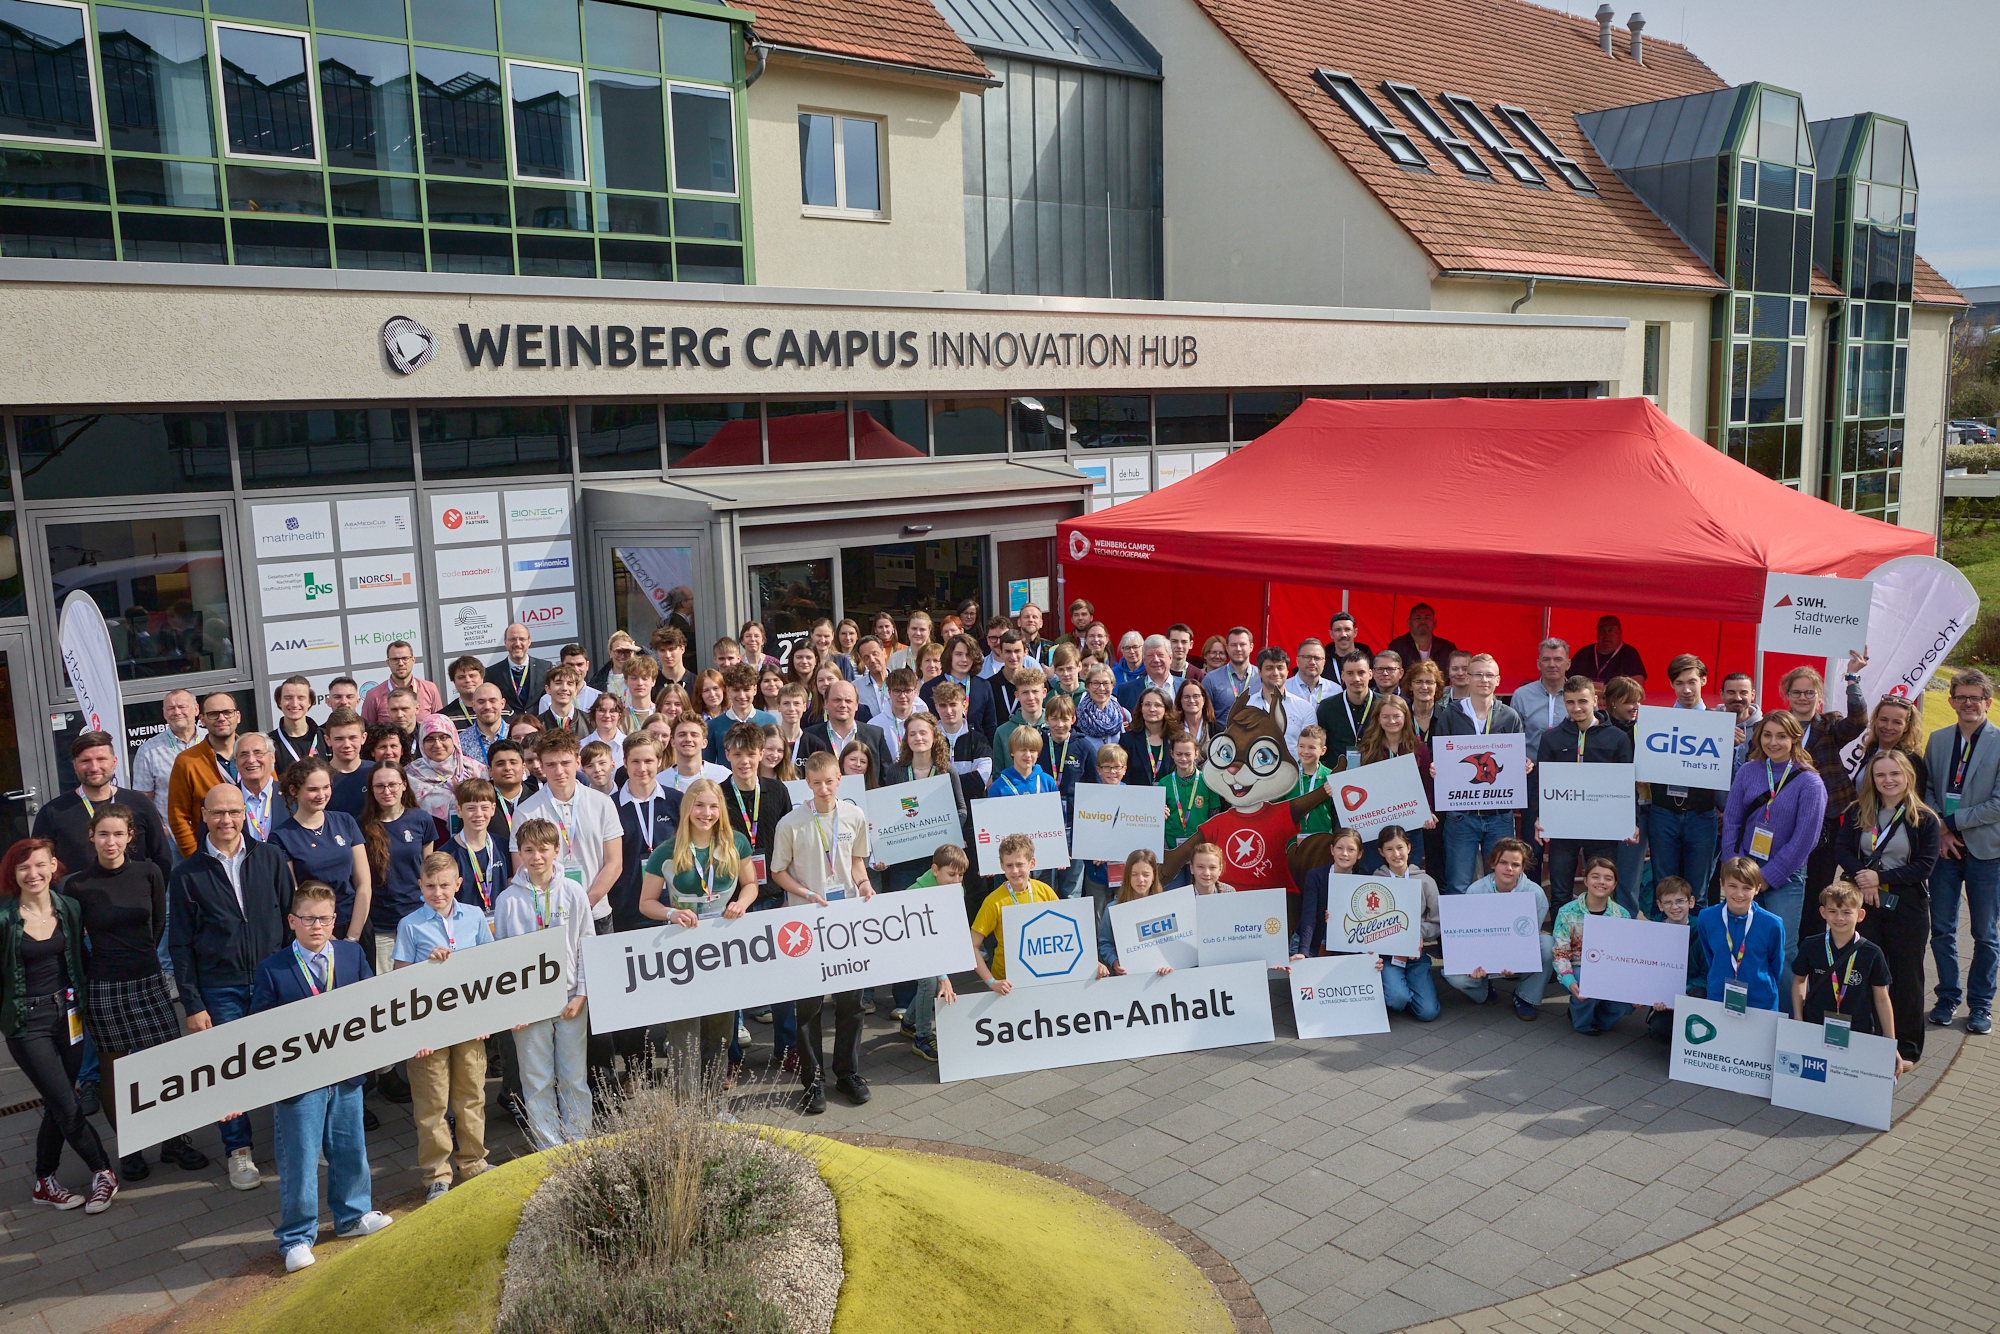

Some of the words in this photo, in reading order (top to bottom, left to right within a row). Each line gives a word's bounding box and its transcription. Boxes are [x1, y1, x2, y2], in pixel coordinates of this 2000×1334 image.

[458, 323, 730, 367] WEINBERG
[745, 326, 919, 368] CAMPUS
[931, 330, 1131, 367] INNOVATION
[1141, 334, 1198, 367] HUB
[511, 507, 563, 518] BIONTECH
[262, 530, 326, 543] matrihealth
[1093, 547, 1151, 560] TECHNOLOGIEPARK
[1094, 539, 1127, 549] WEINBERG
[1127, 542, 1156, 552] CAMPUS
[359, 573, 394, 584] NORCSI
[305, 583, 333, 596] GNS
[1796, 596, 1827, 609] SWH.
[522, 606, 564, 623] IADP
[1794, 610, 1860, 627] Stadtwerke
[463, 623, 494, 631] KOMPETENZ
[776, 630, 809, 639] Weinbergweg
[1792, 623, 1823, 636] Halle
[270, 638, 308, 652] AIM
[354, 633, 370, 645] HK
[373, 629, 417, 643] Biotech
[464, 638, 497, 646] WIRTSCHAFT
[1902, 617, 1962, 688] forscht
[1456, 742, 1513, 751] Sparkassen-Eisdom
[1681, 759, 1708, 771] That's
[1709, 763, 1720, 771] IT.
[1448, 788, 1481, 800] SAALE
[1482, 787, 1514, 799] BULLS
[1078, 810, 1113, 823] Navigo
[1120, 811, 1158, 823] Proteins
[1347, 807, 1387, 823] WEINBERG
[1386, 799, 1419, 813] CAMPUS
[1350, 808, 1418, 830] TECHNOLOGIEPARK
[877, 813, 952, 837] SACHSEN-ANHALT
[886, 834, 919, 847] Ministerium
[918, 832, 927, 840] für
[927, 828, 948, 838] Bildung
[994, 830, 1063, 844] Saarkasse
[1140, 918, 1173, 937] ECH
[1234, 924, 1262, 933] Rotary
[1348, 915, 1401, 944] Halloren
[1364, 924, 1402, 944] ERLEBNISWELT
[1443, 927, 1511, 935] MAX-PLANCK-INSTITUT
[1027, 933, 1075, 957] MERZ
[1125, 935, 1175, 954] ELEKTROCHEMIE
[1174, 930, 1194, 940] HALLE
[1227, 934, 1247, 942] Händel
[624, 923, 777, 994] jugend
[813, 902, 939, 953] forscht
[820, 957, 871, 982] junior
[1605, 954, 1658, 967] PLANETARIUM
[1660, 962, 1685, 970] HALLE
[1317, 984, 1375, 999] SONOTEC
[975, 988, 1236, 1046] Sachsen-Anhalt
[130, 952, 561, 1115] Landeswettbewerb
[1683, 1048, 1731, 1064] WEINBERG
[1732, 1057, 1772, 1072] CAMPUS
[1803, 1057, 1826, 1073] IHK
[1683, 1057, 1720, 1071] FREUNDE
[1720, 1064, 1727, 1073] &
[1728, 1066, 1771, 1081] FÖRDERER
